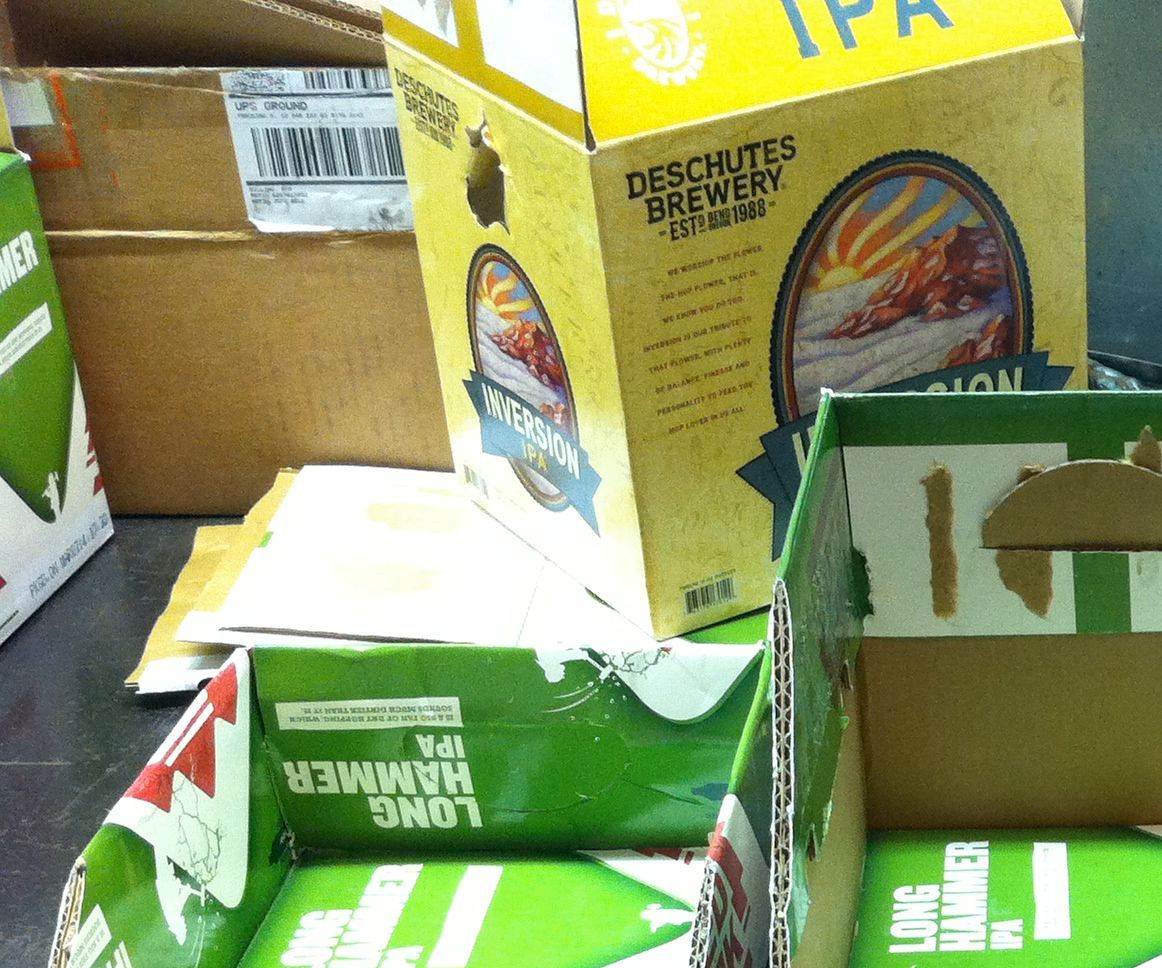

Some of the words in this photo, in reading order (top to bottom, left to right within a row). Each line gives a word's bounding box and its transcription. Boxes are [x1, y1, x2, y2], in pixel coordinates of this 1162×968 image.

[234, 101, 258, 111] UPS
[264, 101, 309, 111] GROUND
[625, 134, 797, 200] DESCHUTES
[643, 165, 785, 225] BREWERY
[481, 382, 581, 480] INVERSION
[522, 440, 549, 473] IPA
[415, 734, 466, 759] IPA
[282, 760, 475, 795] HAMMER
[367, 795, 483, 829] LONG
[938, 840, 990, 952] HAMMER
[888, 884, 942, 954] LONG
[990, 918, 1024, 950] IPA
